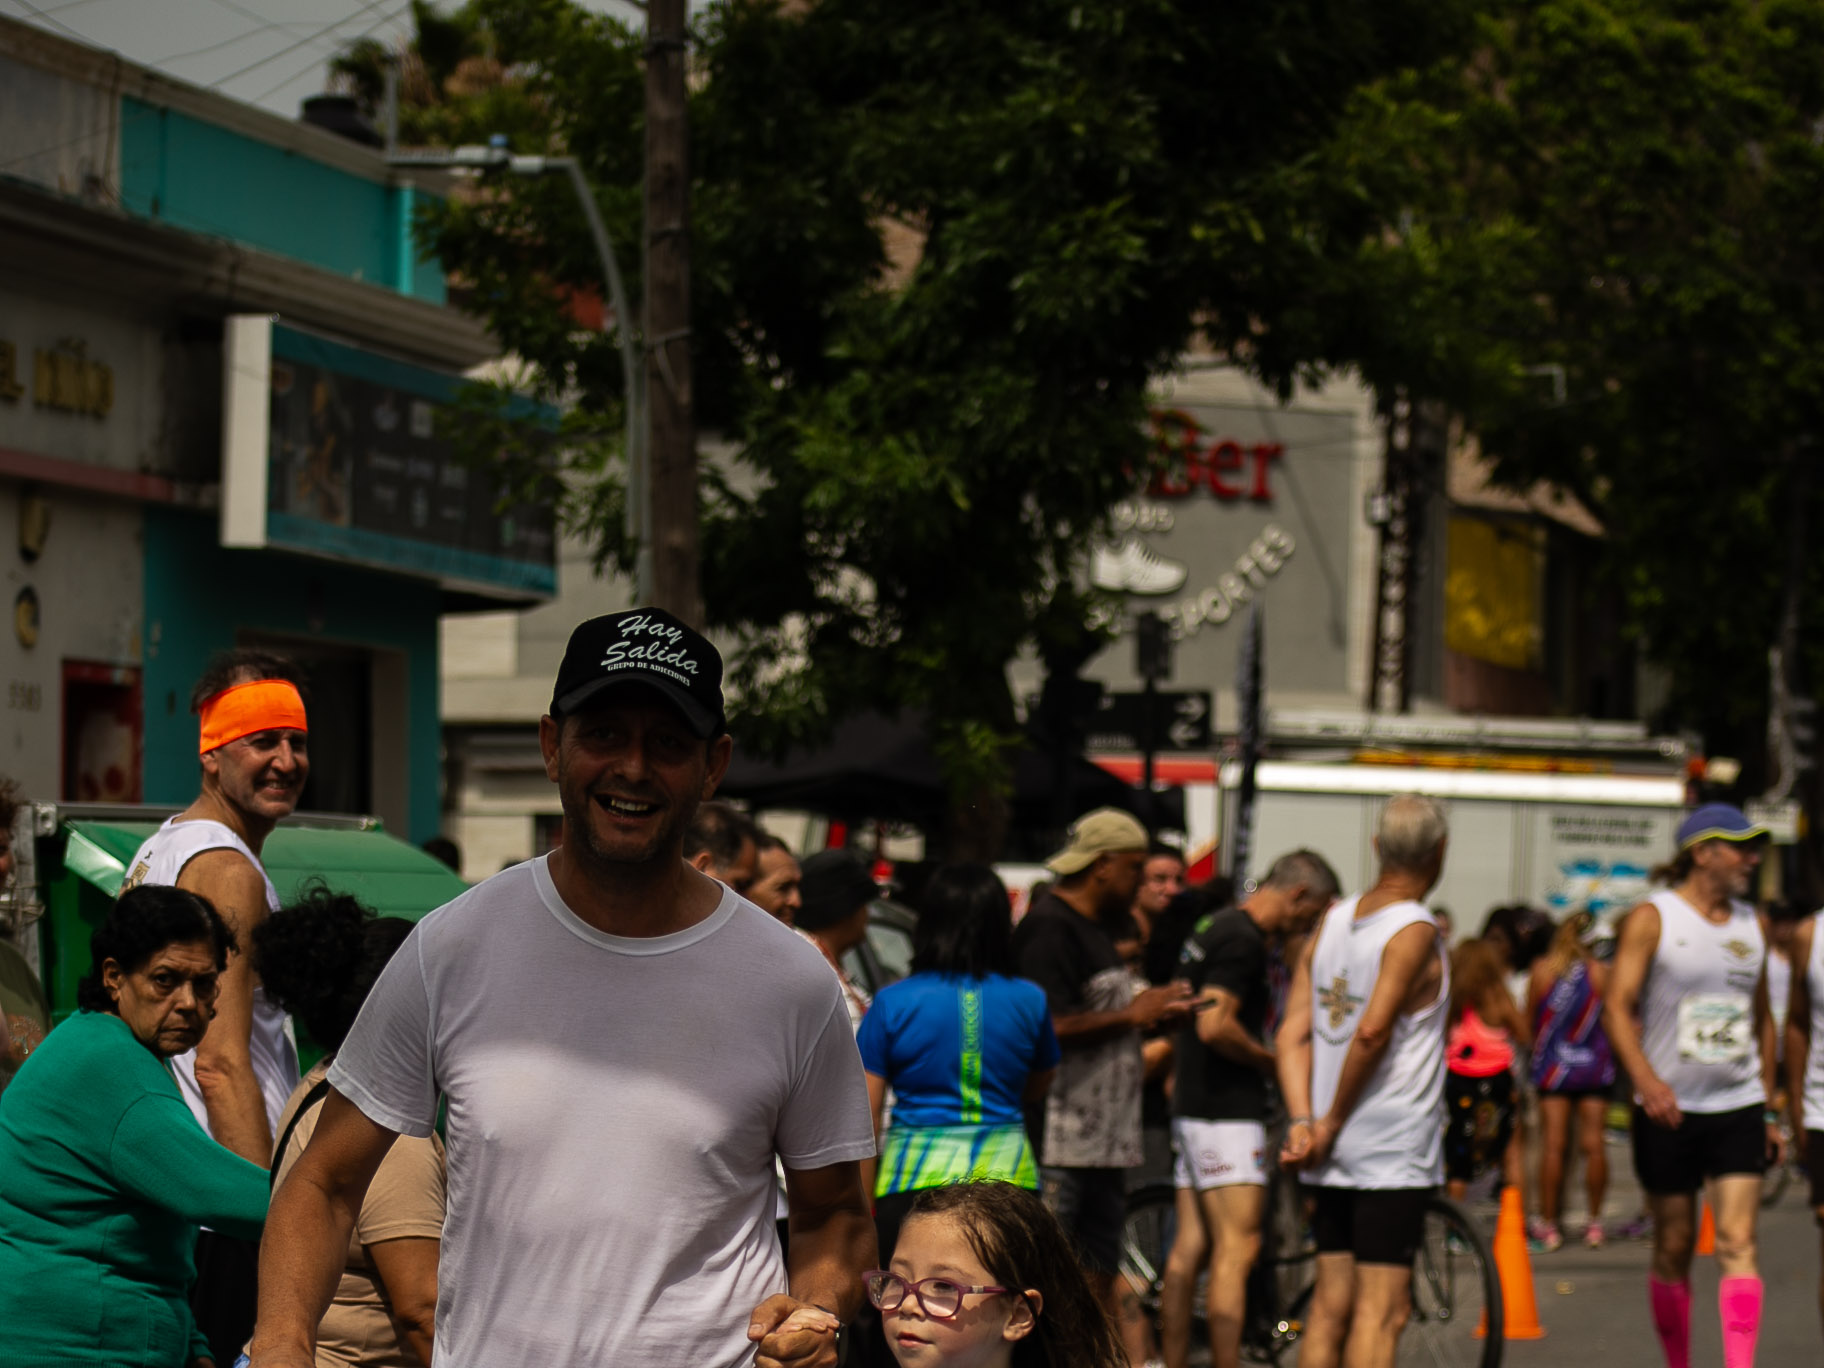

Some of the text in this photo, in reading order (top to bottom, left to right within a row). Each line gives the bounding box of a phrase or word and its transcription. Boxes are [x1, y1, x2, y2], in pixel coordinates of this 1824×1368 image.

[617, 615, 683, 645] Hay
[601, 641, 699, 674] Salida
[607, 662, 634, 672] GRUPO
[650, 664, 690, 687] ADICCIONES
